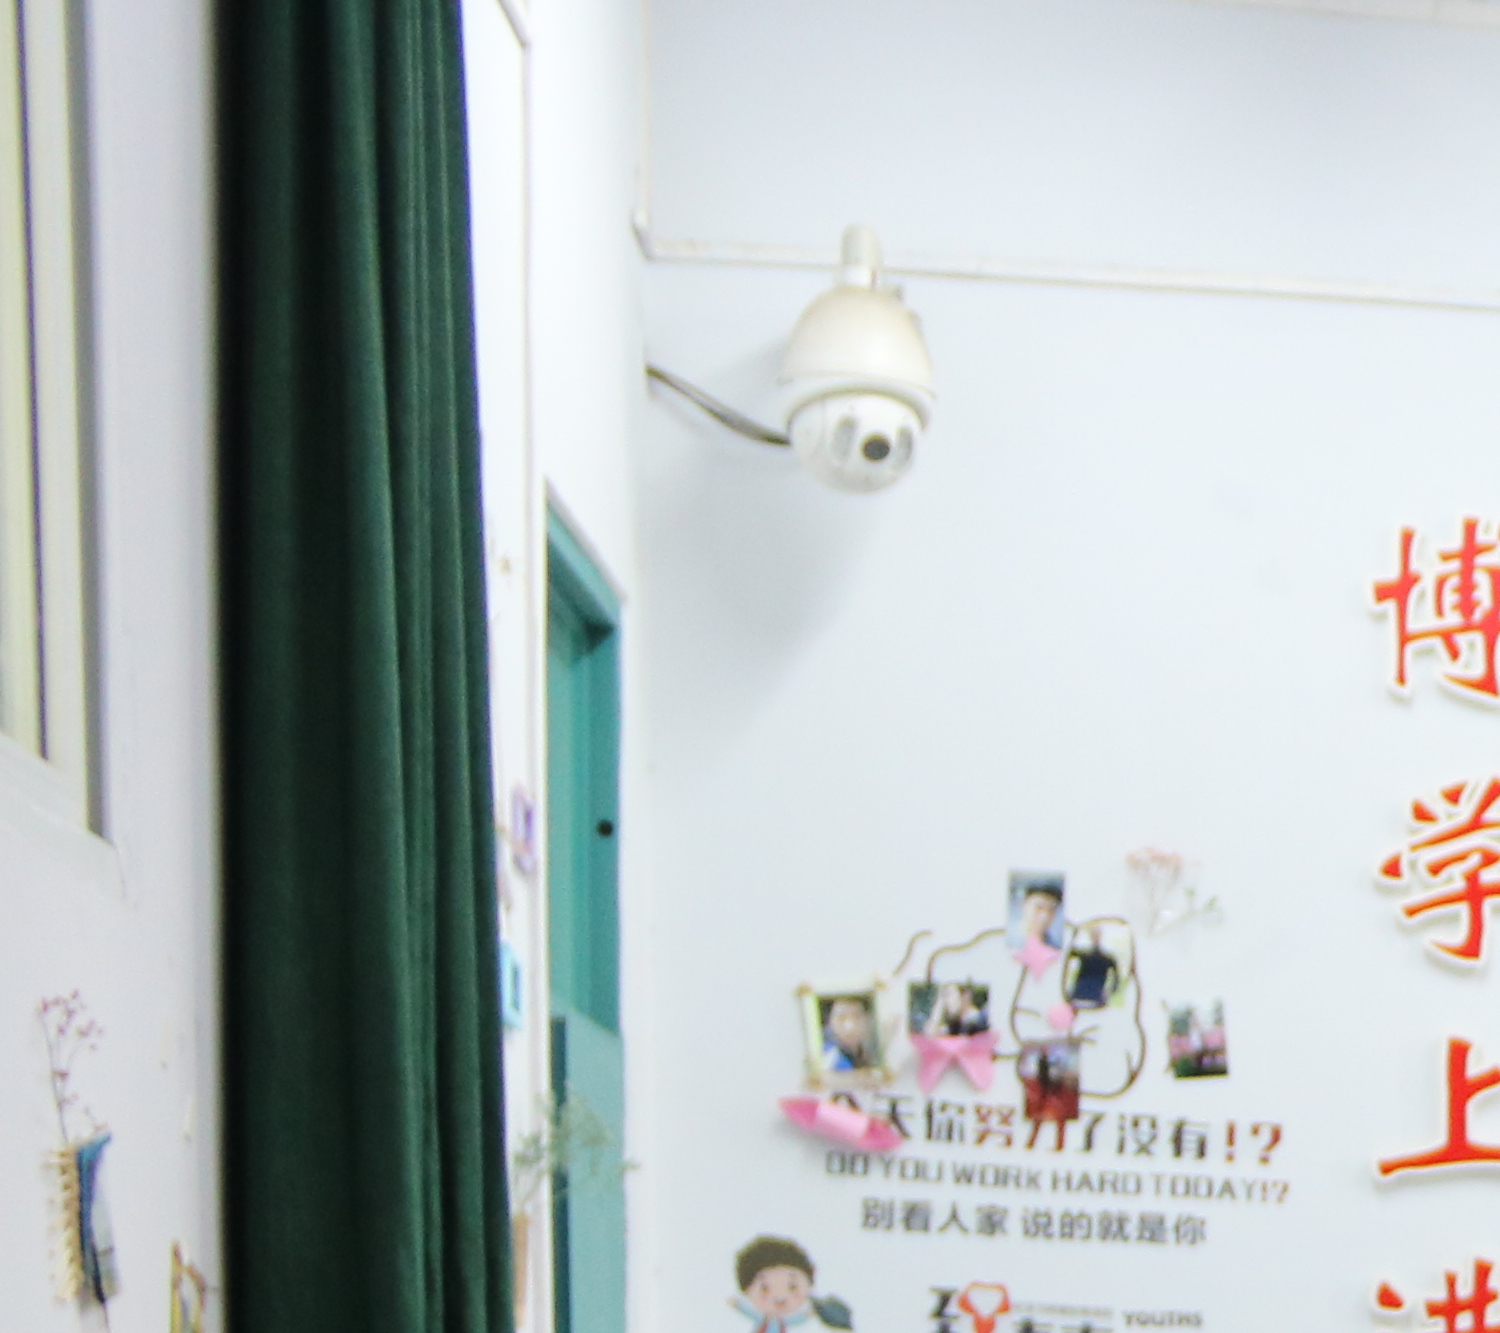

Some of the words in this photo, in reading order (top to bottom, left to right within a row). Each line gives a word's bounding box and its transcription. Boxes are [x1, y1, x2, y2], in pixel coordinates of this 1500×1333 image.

[825, 1151, 871, 1177] DO
[881, 1155, 943, 1185] YOU
[952, 1163, 1043, 1191] WORK
[1050, 1168, 1143, 1198] HARD
[1153, 1174, 1290, 1205] TODAY!?
[861, 1197, 1010, 1238] 别看人家
[1020, 1207, 1208, 1247] 说的就是你
